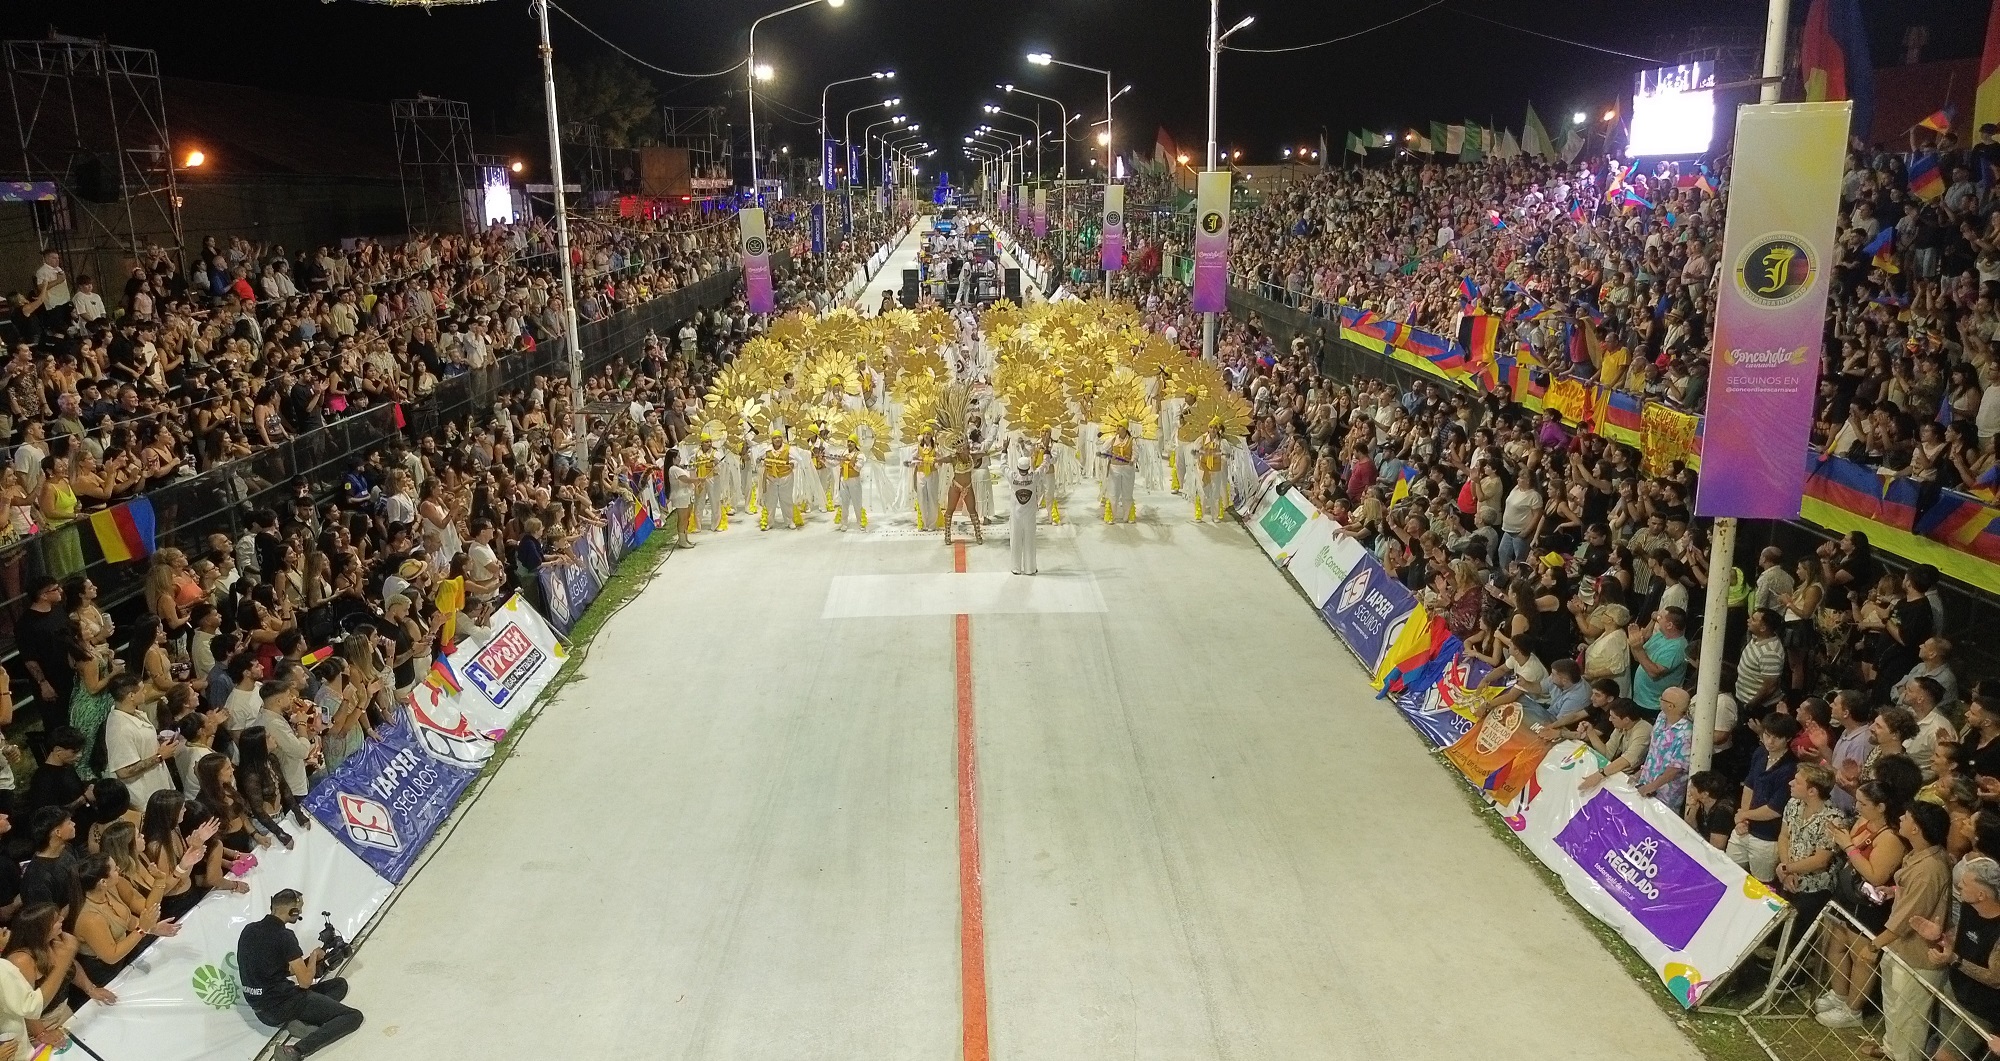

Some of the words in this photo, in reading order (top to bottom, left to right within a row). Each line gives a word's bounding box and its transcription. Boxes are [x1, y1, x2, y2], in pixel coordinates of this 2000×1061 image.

[1731, 347, 1792, 365] Concordia
[1727, 376, 1780, 385] SEGUINOS
[1784, 377, 1799, 385] EN
[1354, 604, 1382, 635] SEGUROS
[1364, 587, 1395, 620] IAPSER
[371, 748, 421, 800] IAPSER
[393, 765, 438, 816] SEGUROS
[1604, 849, 1659, 900] REGALADO
[1623, 844, 1658, 879] TODO
